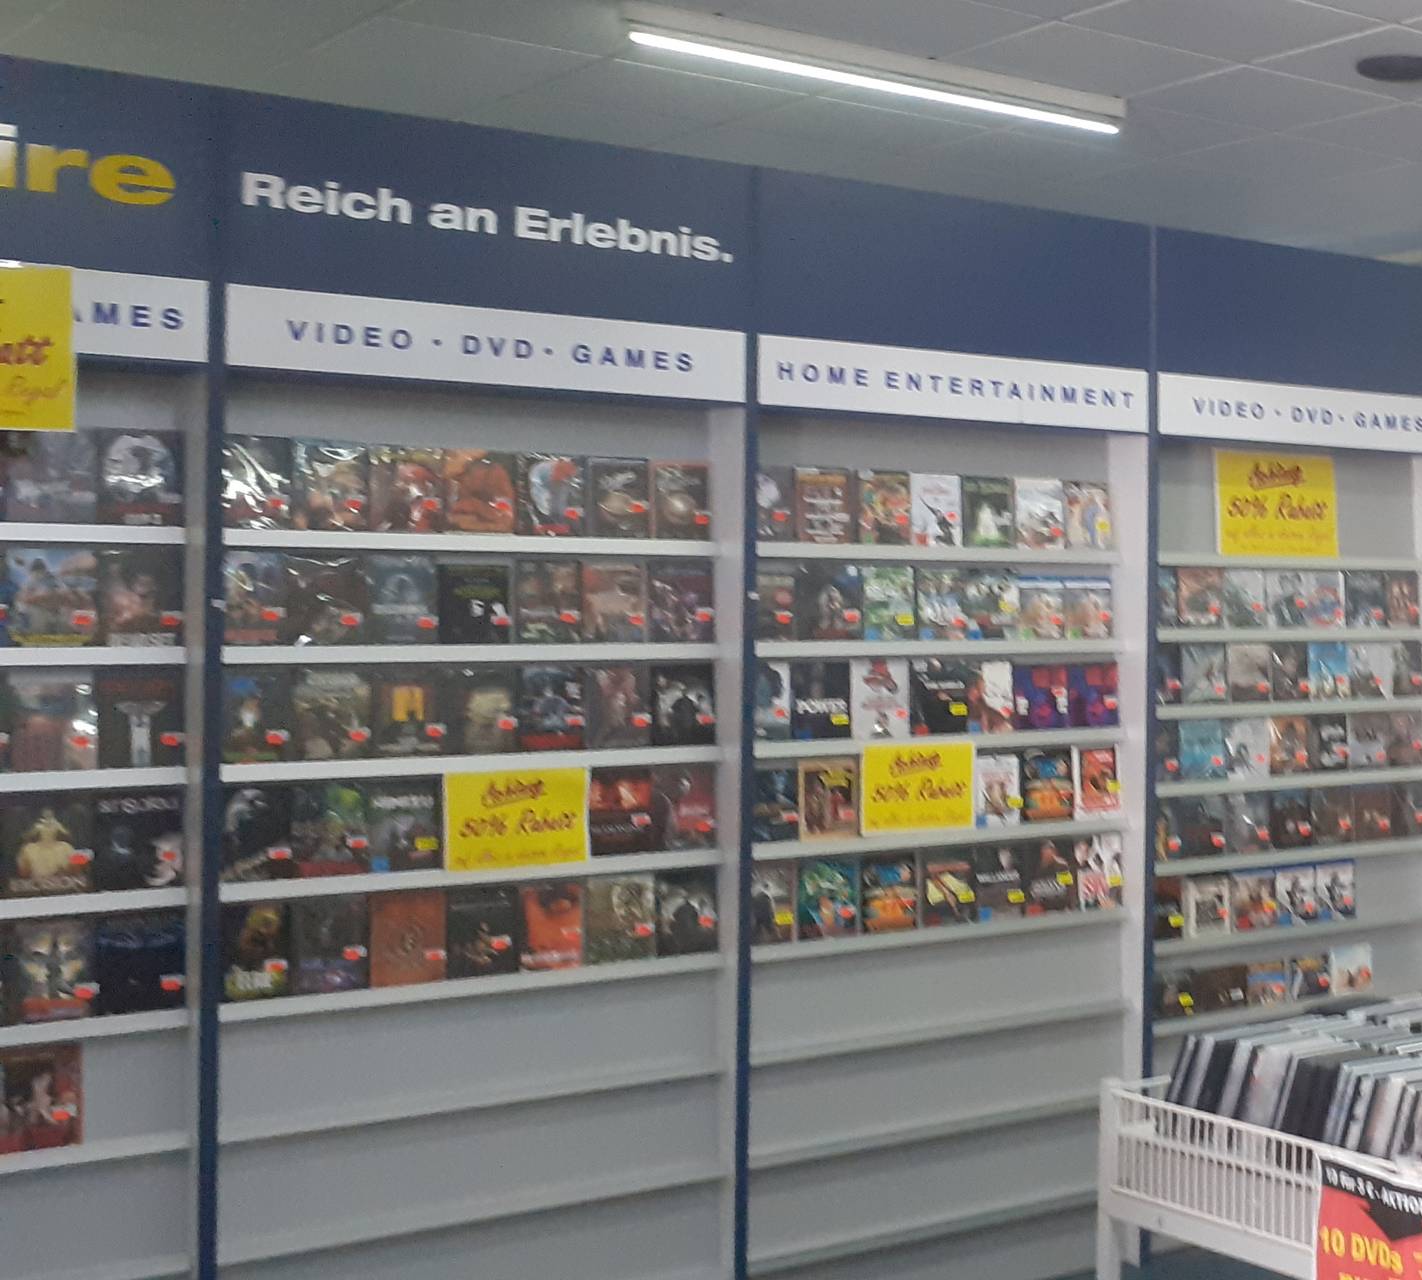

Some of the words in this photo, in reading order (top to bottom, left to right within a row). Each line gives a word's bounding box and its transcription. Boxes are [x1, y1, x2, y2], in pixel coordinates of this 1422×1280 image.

[241, 171, 411, 227] Reich
[428, 203, 499, 237] an
[513, 205, 734, 264] Erlebnis.
[74, 301, 185, 331] MES
[285, 319, 416, 351] VIDEO
[461, 335, 536, 361] DVD
[572, 344, 696, 374] GAMES
[776, 360, 870, 386] HOME
[884, 371, 1135, 410] ENTERTAINMENT
[1192, 396, 1265, 421] VIDEO
[1290, 406, 1334, 426] DVD
[1318, 1225, 1346, 1259] 10
[1350, 1232, 1404, 1275] DVDs
